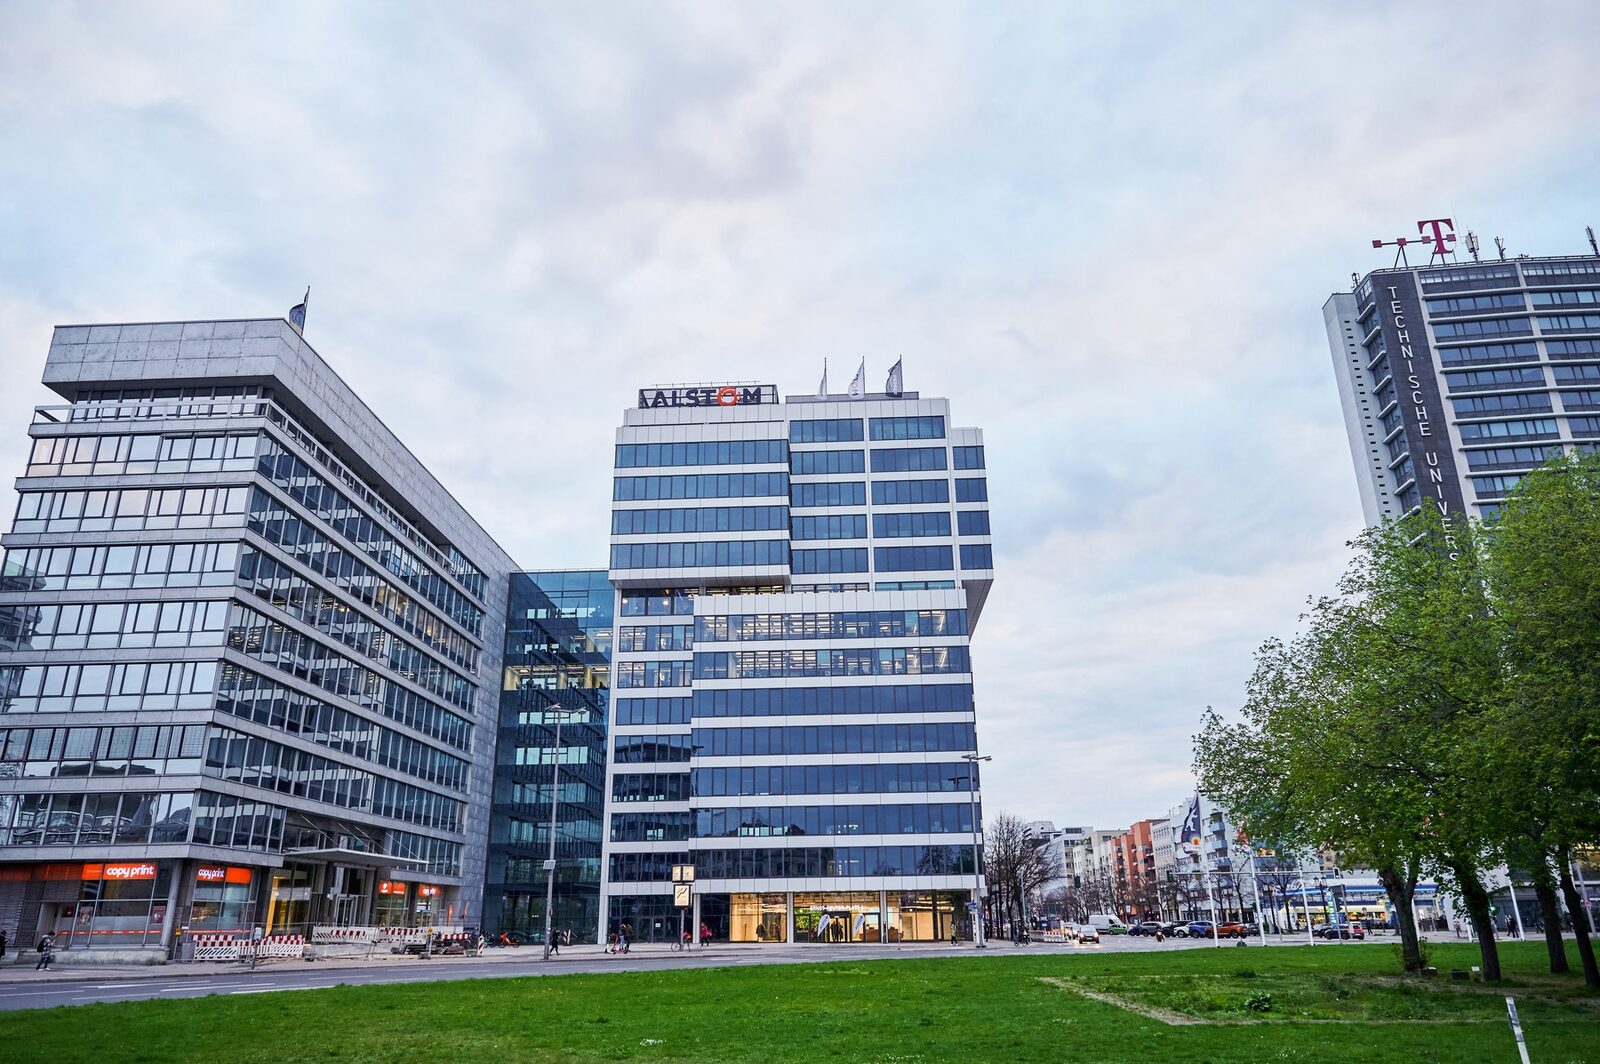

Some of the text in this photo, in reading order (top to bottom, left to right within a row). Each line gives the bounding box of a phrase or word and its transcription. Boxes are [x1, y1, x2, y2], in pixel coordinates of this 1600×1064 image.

[1417, 219, 1454, 254] T
[1387, 286, 1432, 437] TECHNISCHE
[651, 386, 761, 408] ALSTOM
[106, 865, 154, 878] copy print
